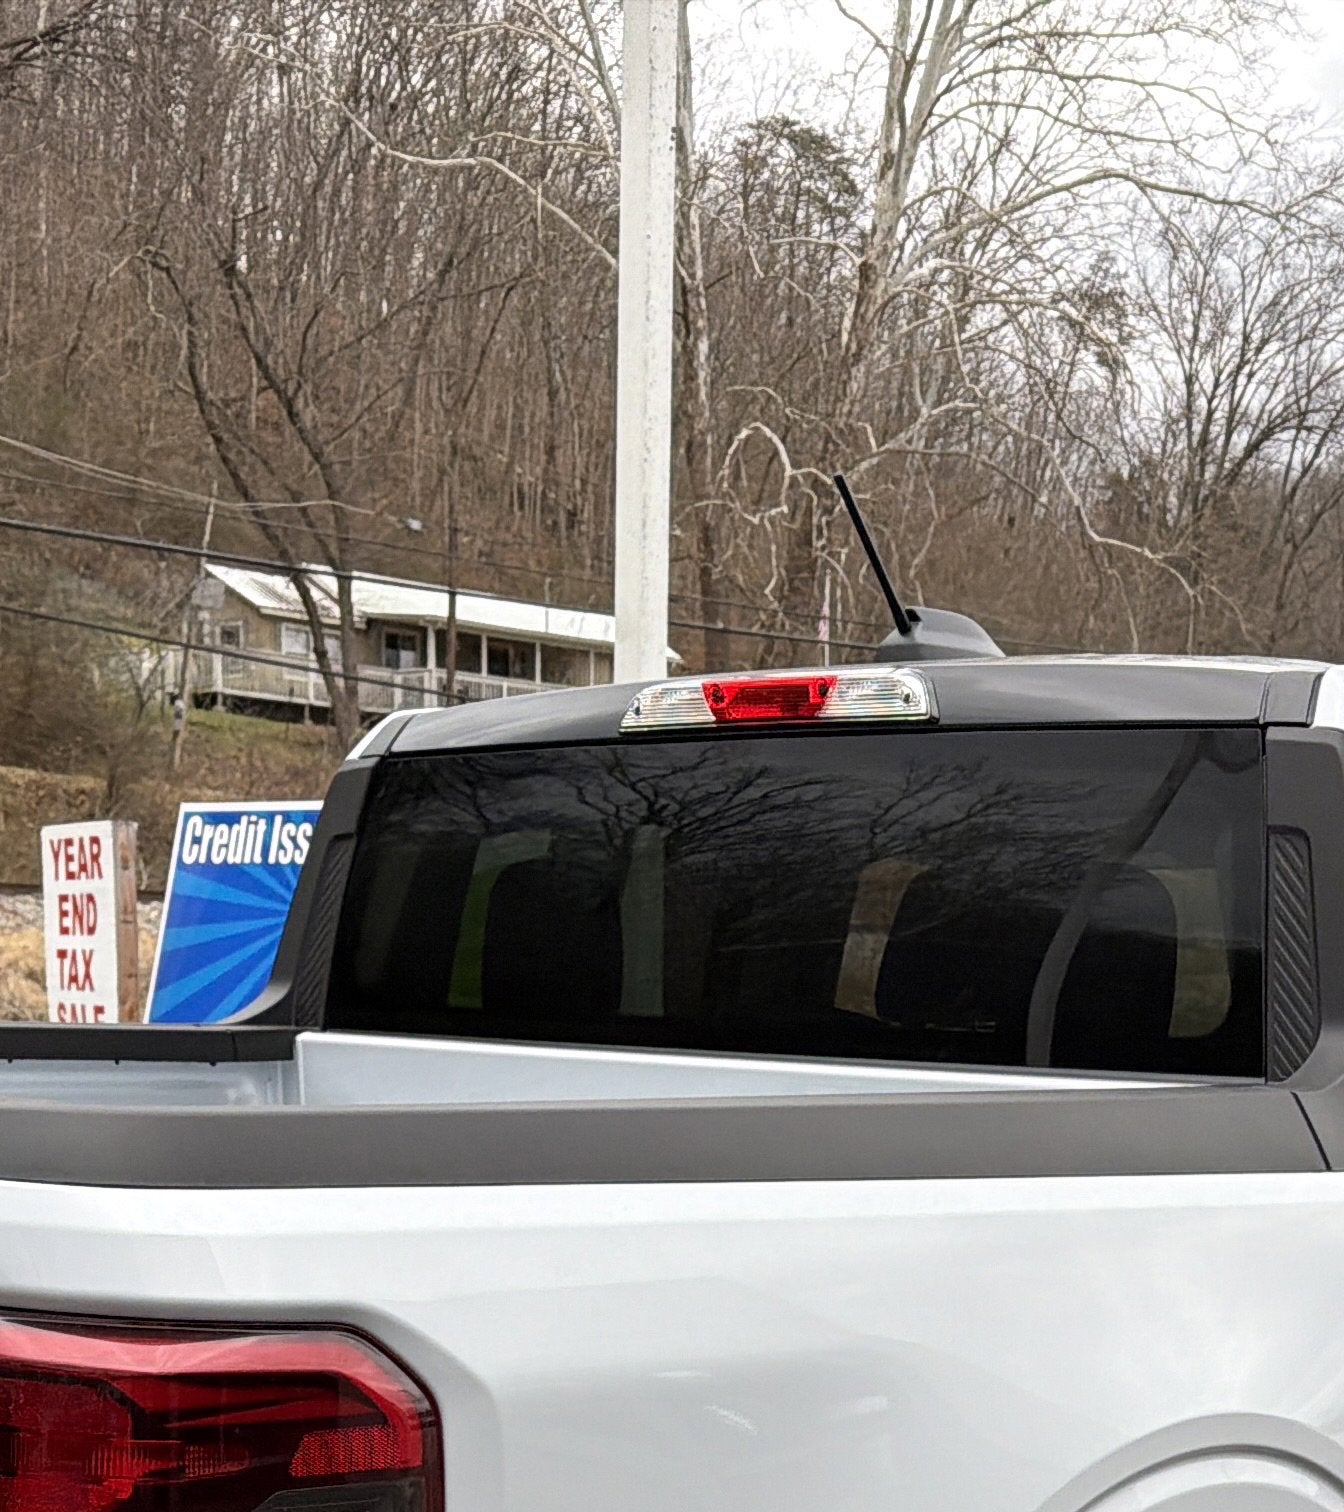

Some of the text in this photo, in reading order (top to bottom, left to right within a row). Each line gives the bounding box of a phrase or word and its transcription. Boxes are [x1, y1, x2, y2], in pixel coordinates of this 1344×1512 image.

[50, 836, 103, 880] YEAR
[182, 815, 266, 864] Credit
[58, 893, 97, 936] END
[57, 949, 95, 992] TAX
